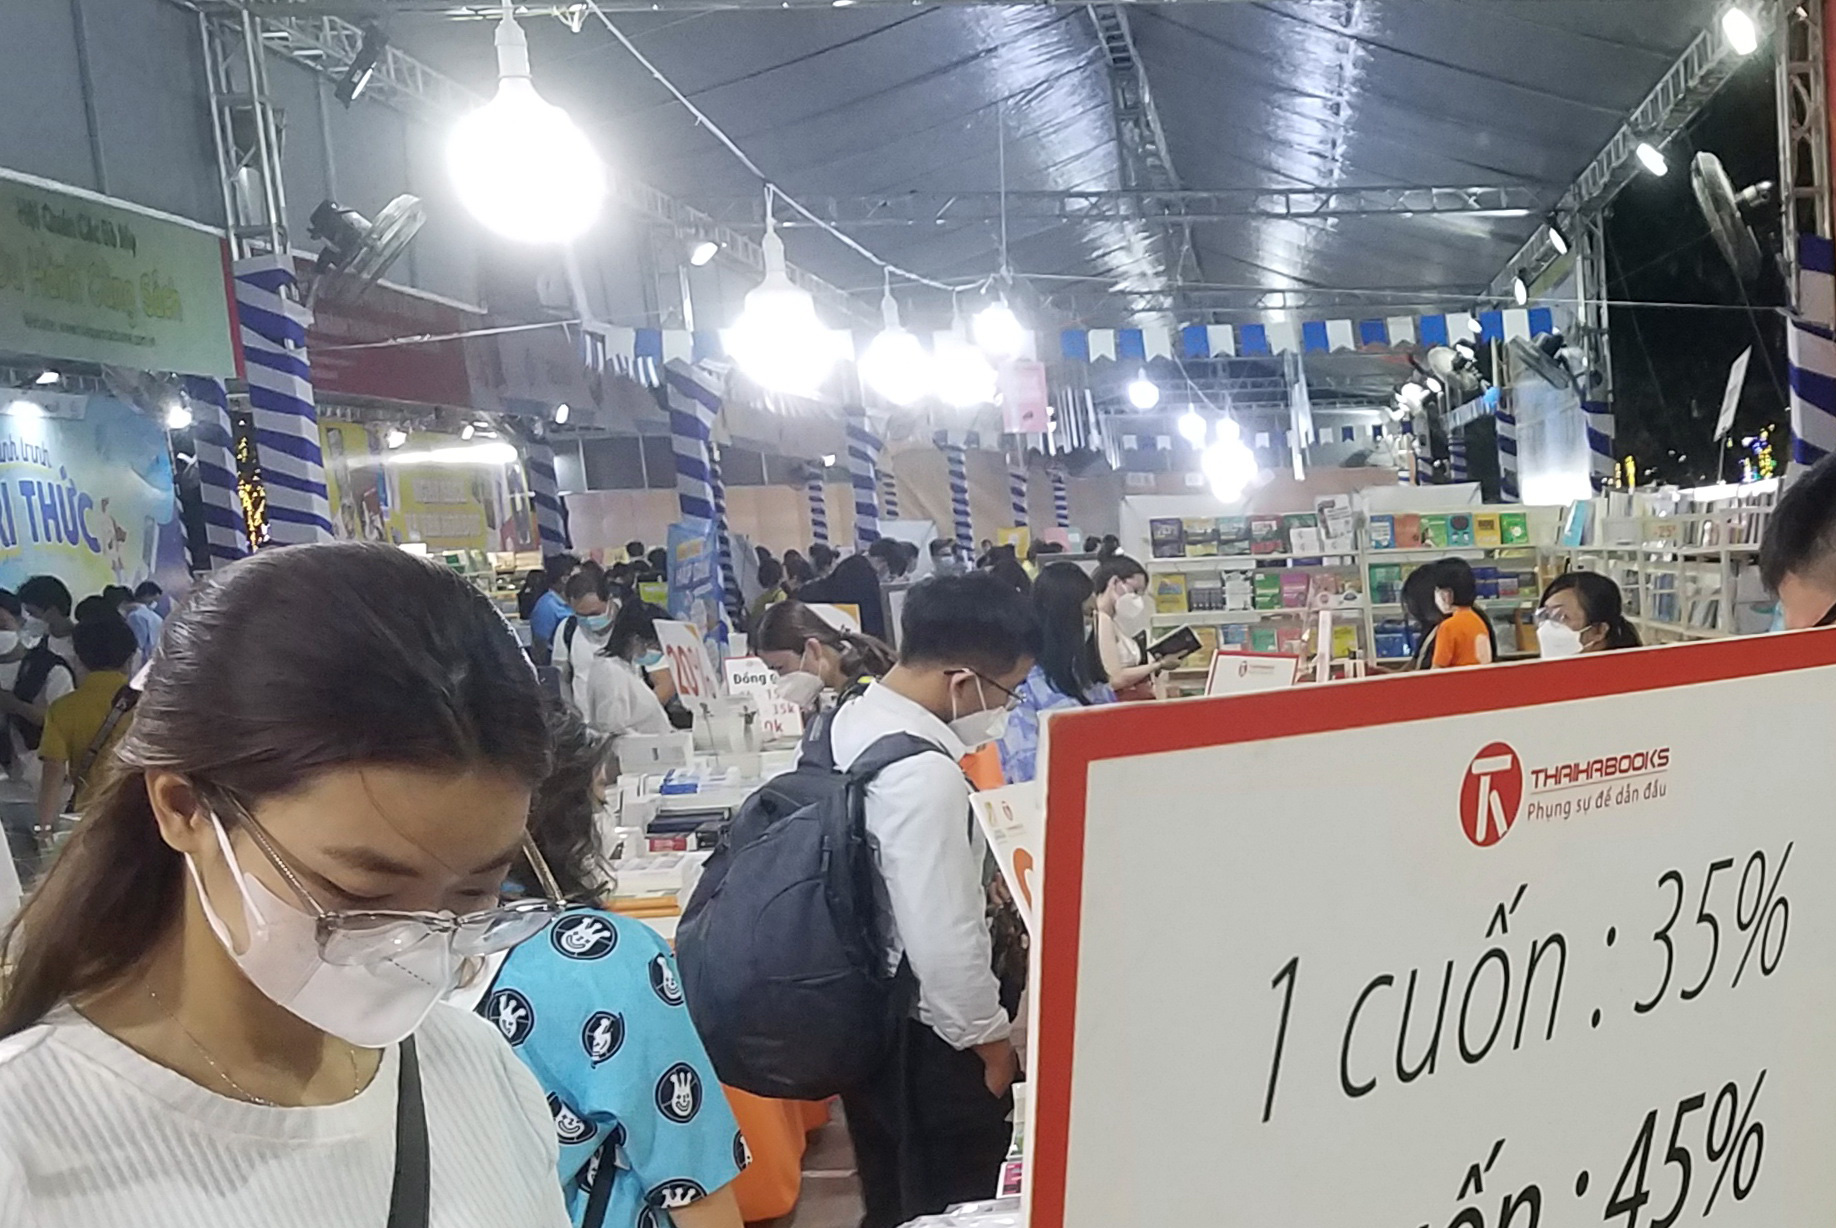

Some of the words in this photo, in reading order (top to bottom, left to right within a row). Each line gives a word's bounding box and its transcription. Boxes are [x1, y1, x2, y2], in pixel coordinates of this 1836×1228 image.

[19, 465, 101, 553] THỨC
[1527, 800, 1571, 822] Phụng
[1576, 797, 1591, 815] sự
[1595, 786, 1612, 810] để
[1616, 783, 1639, 806] dẫn
[1643, 778, 1667, 800] đầu
[1531, 748, 1670, 789] THAIHABOOKS
[1261, 956, 1300, 1123] 1
[1338, 883, 1568, 1100] cuốn
[1633, 841, 1795, 1015] 35%
